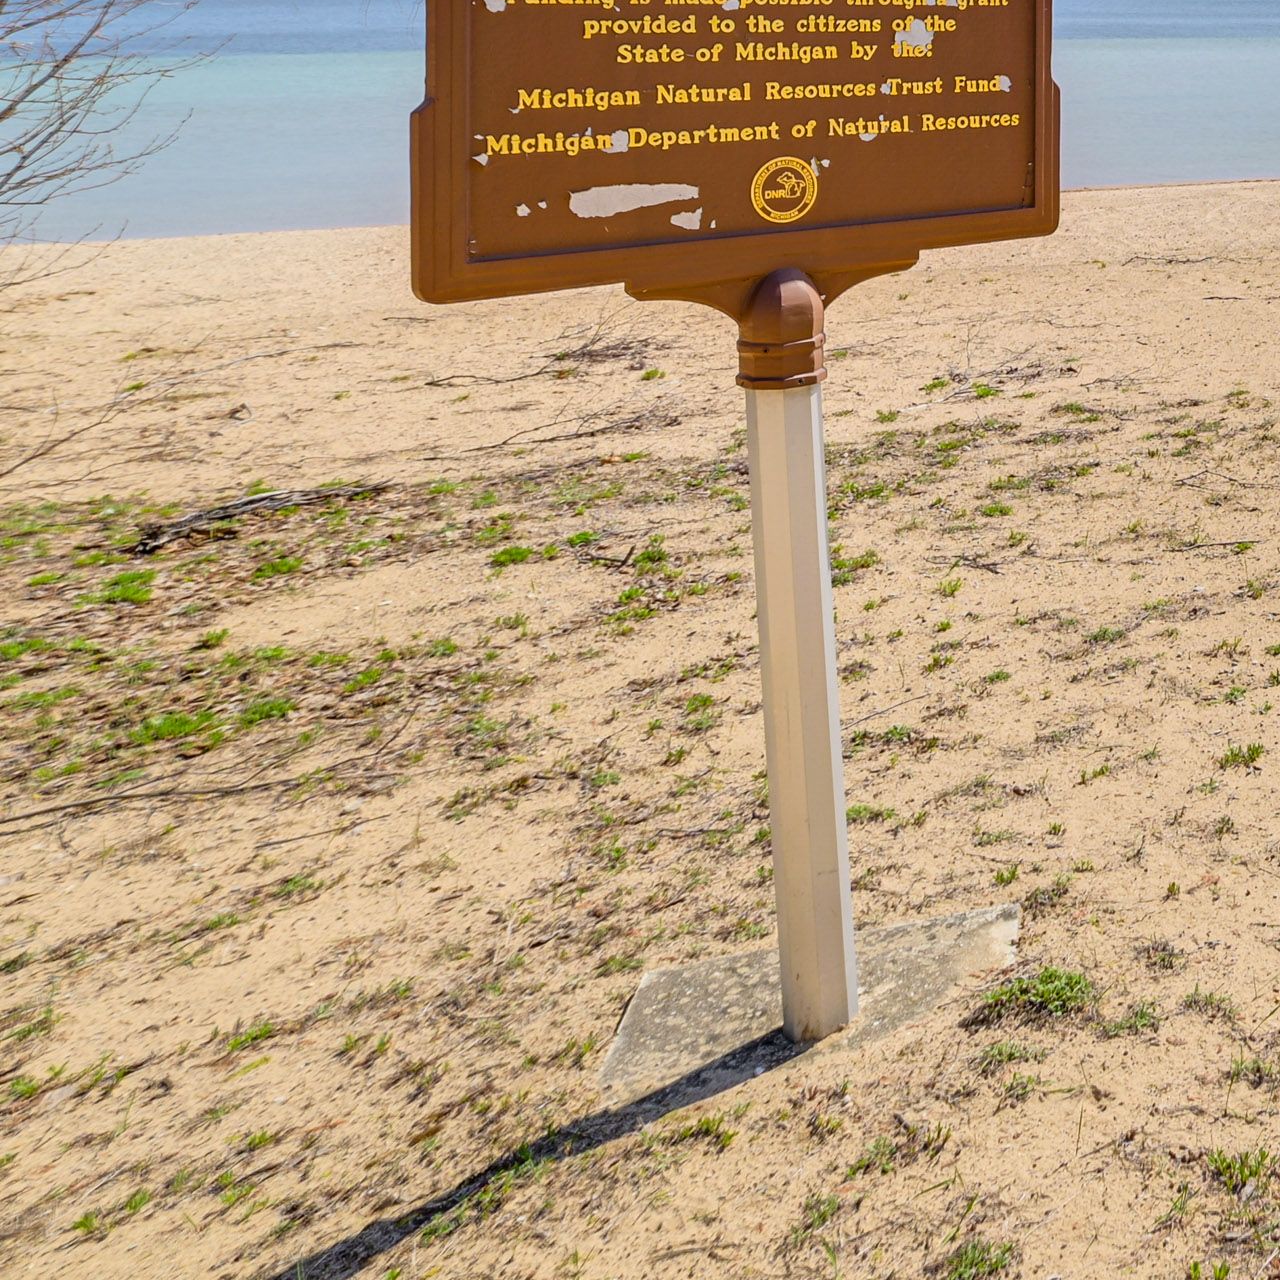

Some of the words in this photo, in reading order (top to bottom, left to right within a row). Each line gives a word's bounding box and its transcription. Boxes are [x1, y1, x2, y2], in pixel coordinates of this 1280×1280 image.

[584, 15, 696, 38] provided
[709, 16, 735, 32] to
[746, 15, 784, 32] the
[797, 15, 881, 32] citizens
[892, 16, 914, 32] of
[924, 15, 956, 32] the
[617, 44, 684, 63] State
[696, 44, 723, 61] of
[736, 43, 837, 63] Michigan
[851, 41, 877, 60] by
[891, 41, 932, 57] the:
[518, 88, 640, 110] Michigan
[657, 83, 750, 104] Natural
[766, 82, 875, 99] Resources
[887, 77, 942, 95] Trust
[955, 76, 1001, 92] Fund
[486, 133, 613, 155] Michigan
[628, 122, 779, 149] Department
[792, 120, 816, 137] of
[829, 116, 910, 136] Natural
[922, 114, 1019, 130] Resources
[776, 160, 803, 169] NATURAL
[764, 190, 785, 199] DNR
[770, 210, 799, 219] MICHIGAN
